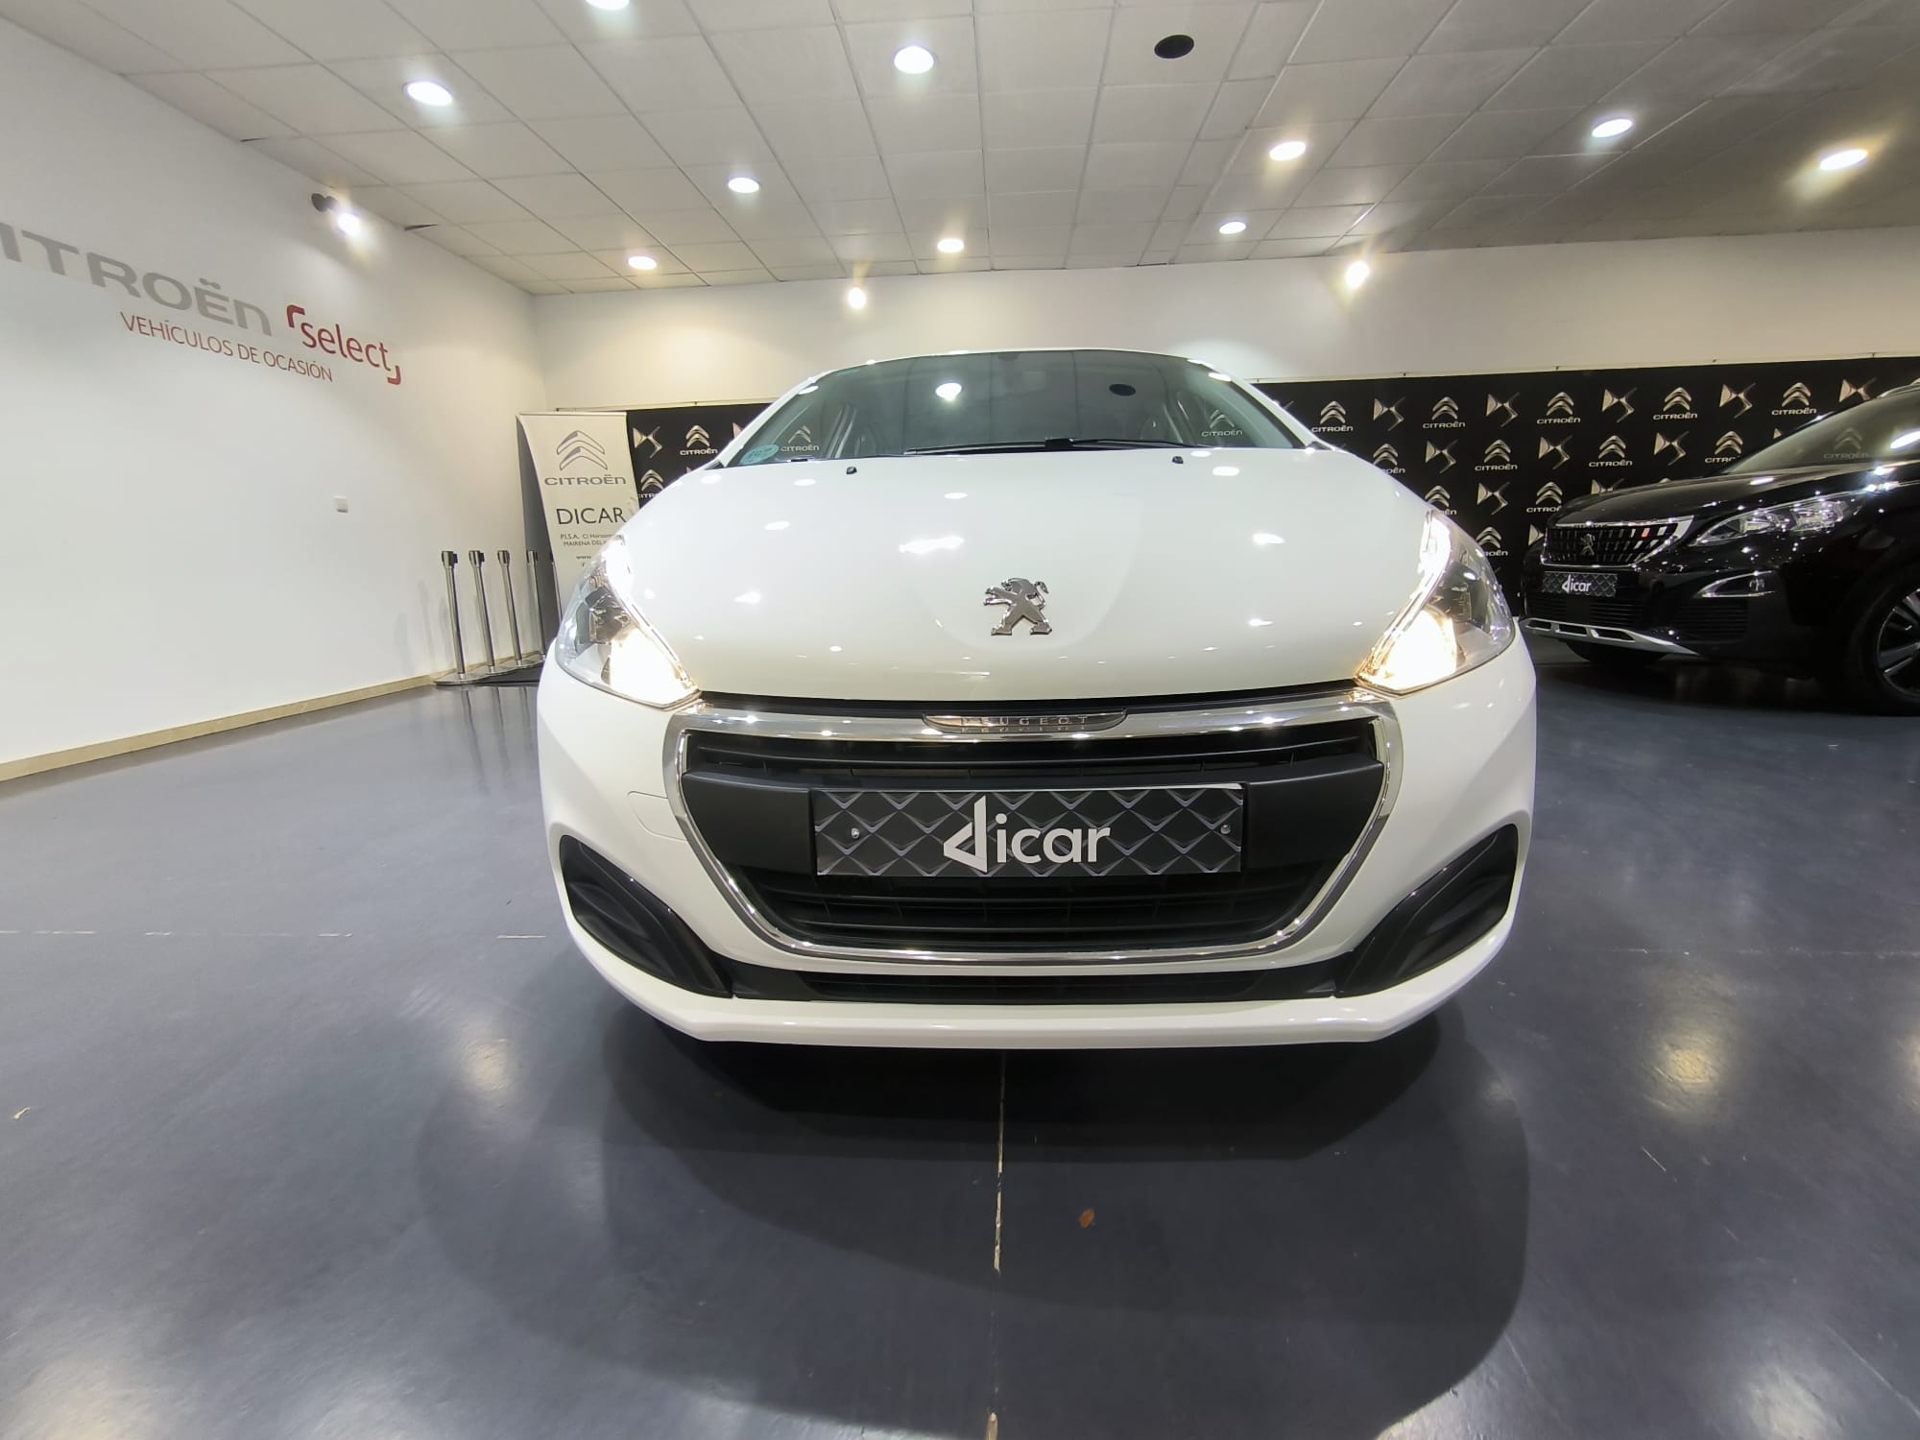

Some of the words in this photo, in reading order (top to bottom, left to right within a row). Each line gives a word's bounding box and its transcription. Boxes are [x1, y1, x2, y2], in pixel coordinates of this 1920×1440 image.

[0, 222, 272, 338] ITROËN
[301, 321, 391, 372] select
[120, 311, 233, 357] VEHÍCULOS
[238, 343, 260, 364] DE
[263, 351, 333, 383] OCASIÓN
[556, 507, 627, 525] DICAR
[960, 715, 1088, 727] PEUGEOT
[943, 795, 1111, 873] dicar
